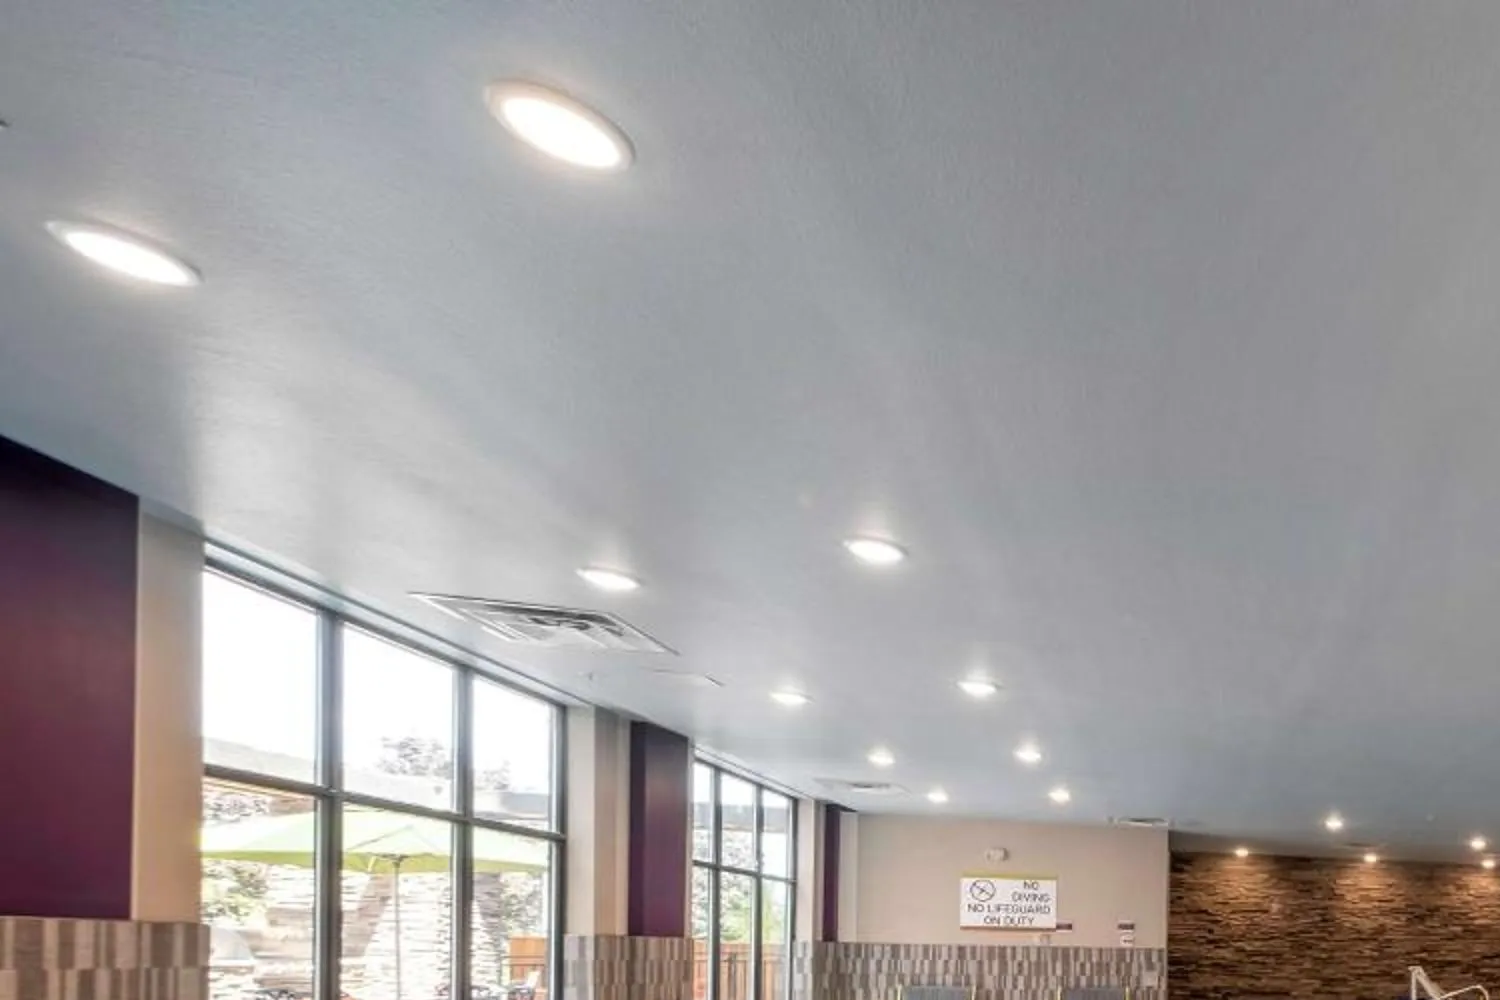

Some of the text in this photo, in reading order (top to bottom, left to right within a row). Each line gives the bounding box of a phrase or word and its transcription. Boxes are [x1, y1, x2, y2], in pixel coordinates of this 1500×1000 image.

[1024, 880, 1039, 890] NO
[1012, 891, 1050, 902] DIVING
[967, 903, 1051, 914] NO LIFEGUARD
[983, 915, 1034, 926] ON DUTY
